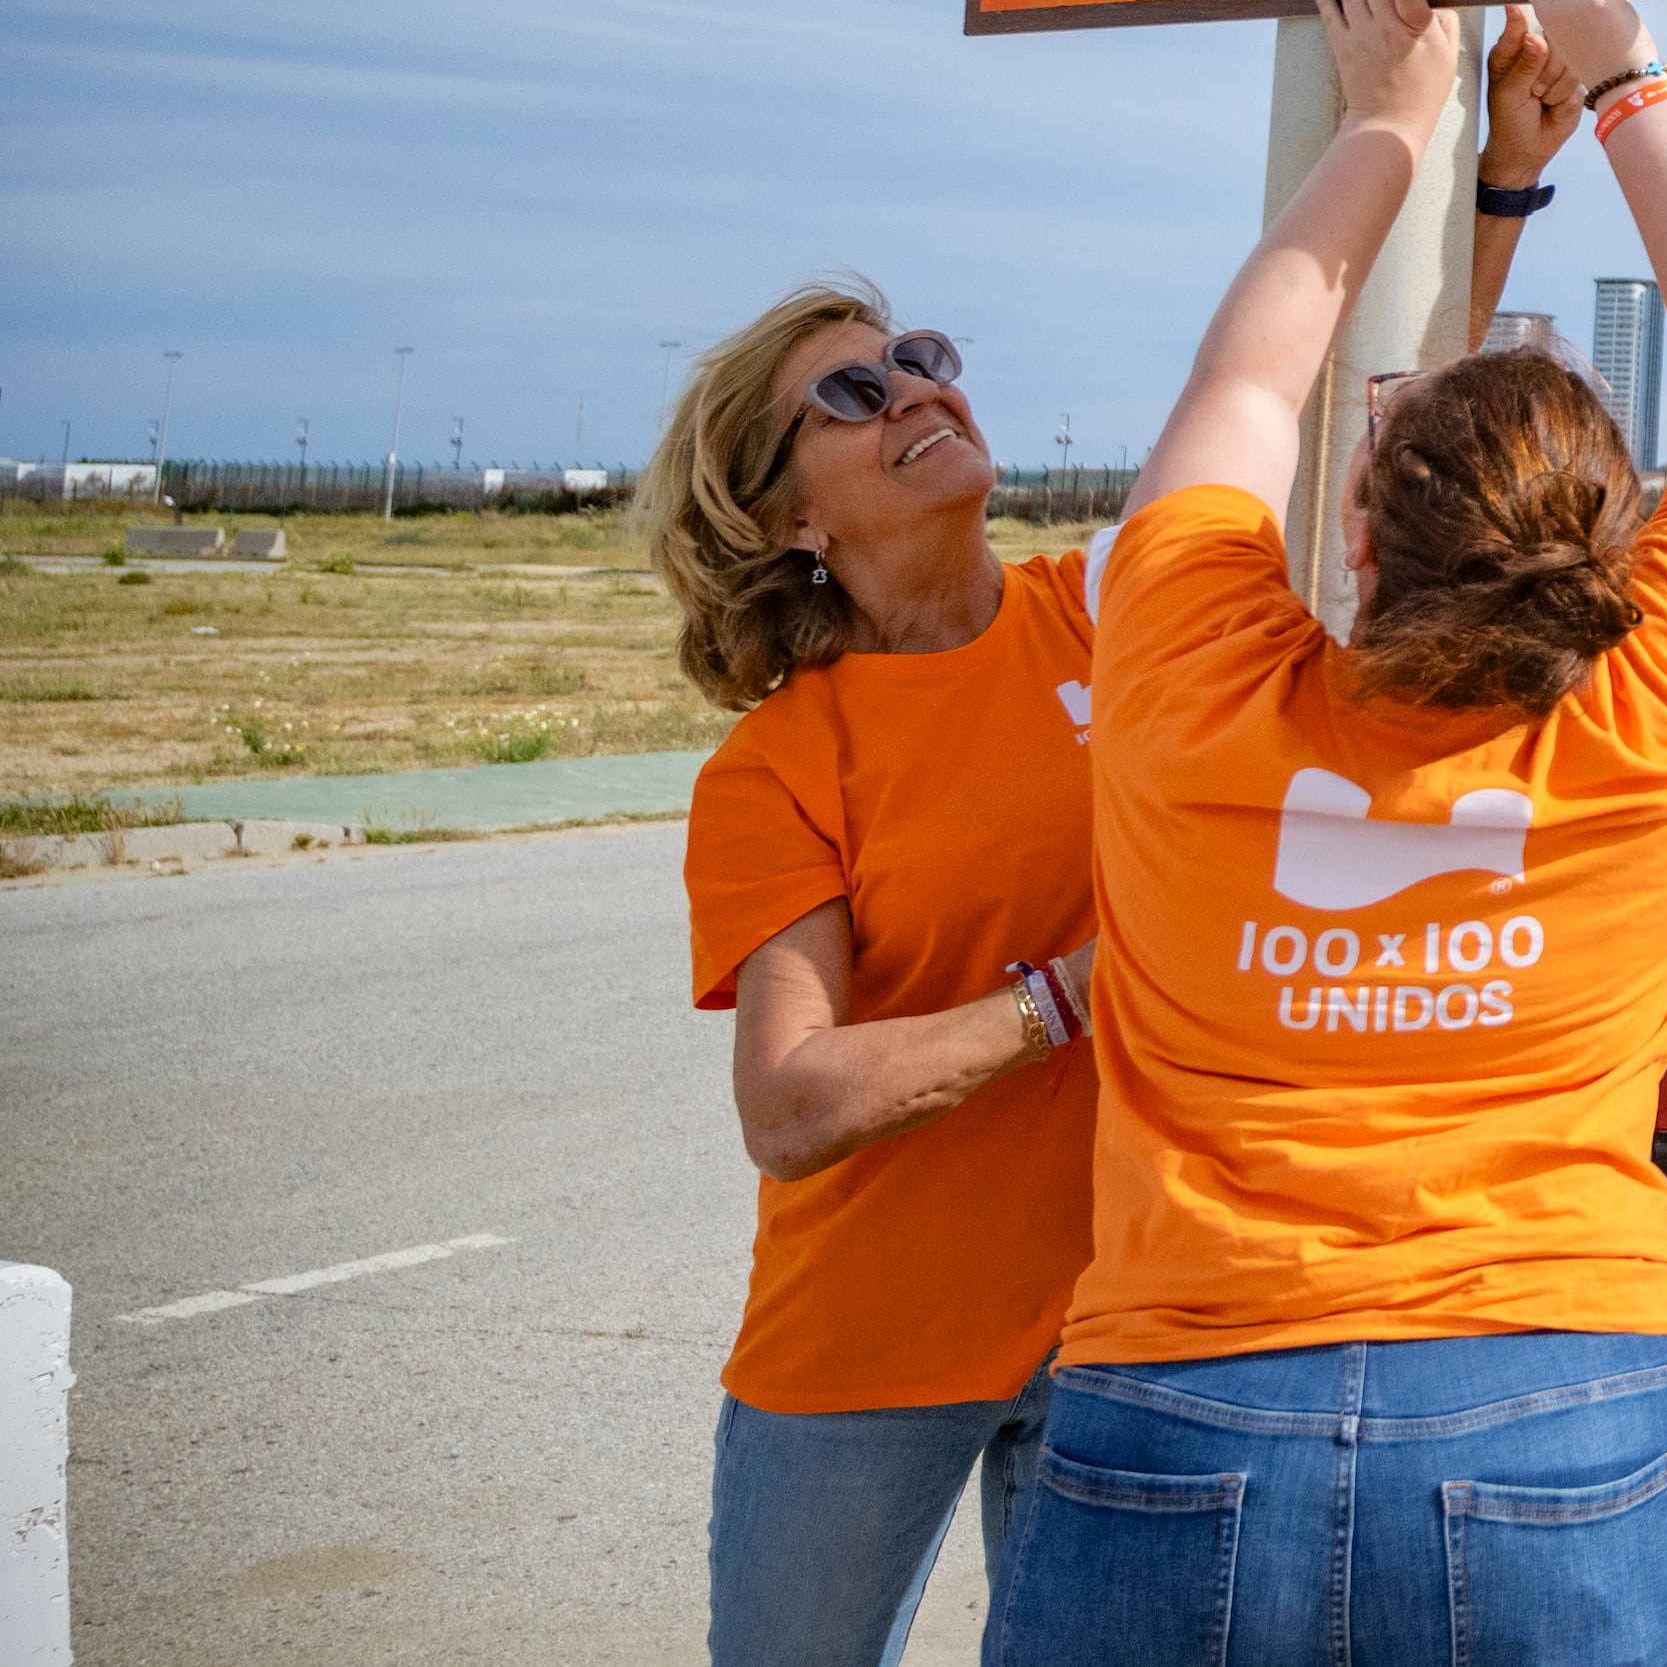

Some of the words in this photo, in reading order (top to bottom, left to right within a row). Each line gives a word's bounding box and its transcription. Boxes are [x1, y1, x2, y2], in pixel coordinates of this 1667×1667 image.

[1238, 920, 1361, 978] 100
[1424, 915, 1545, 974] 100
[1279, 980, 1514, 1032] UNIDOS
